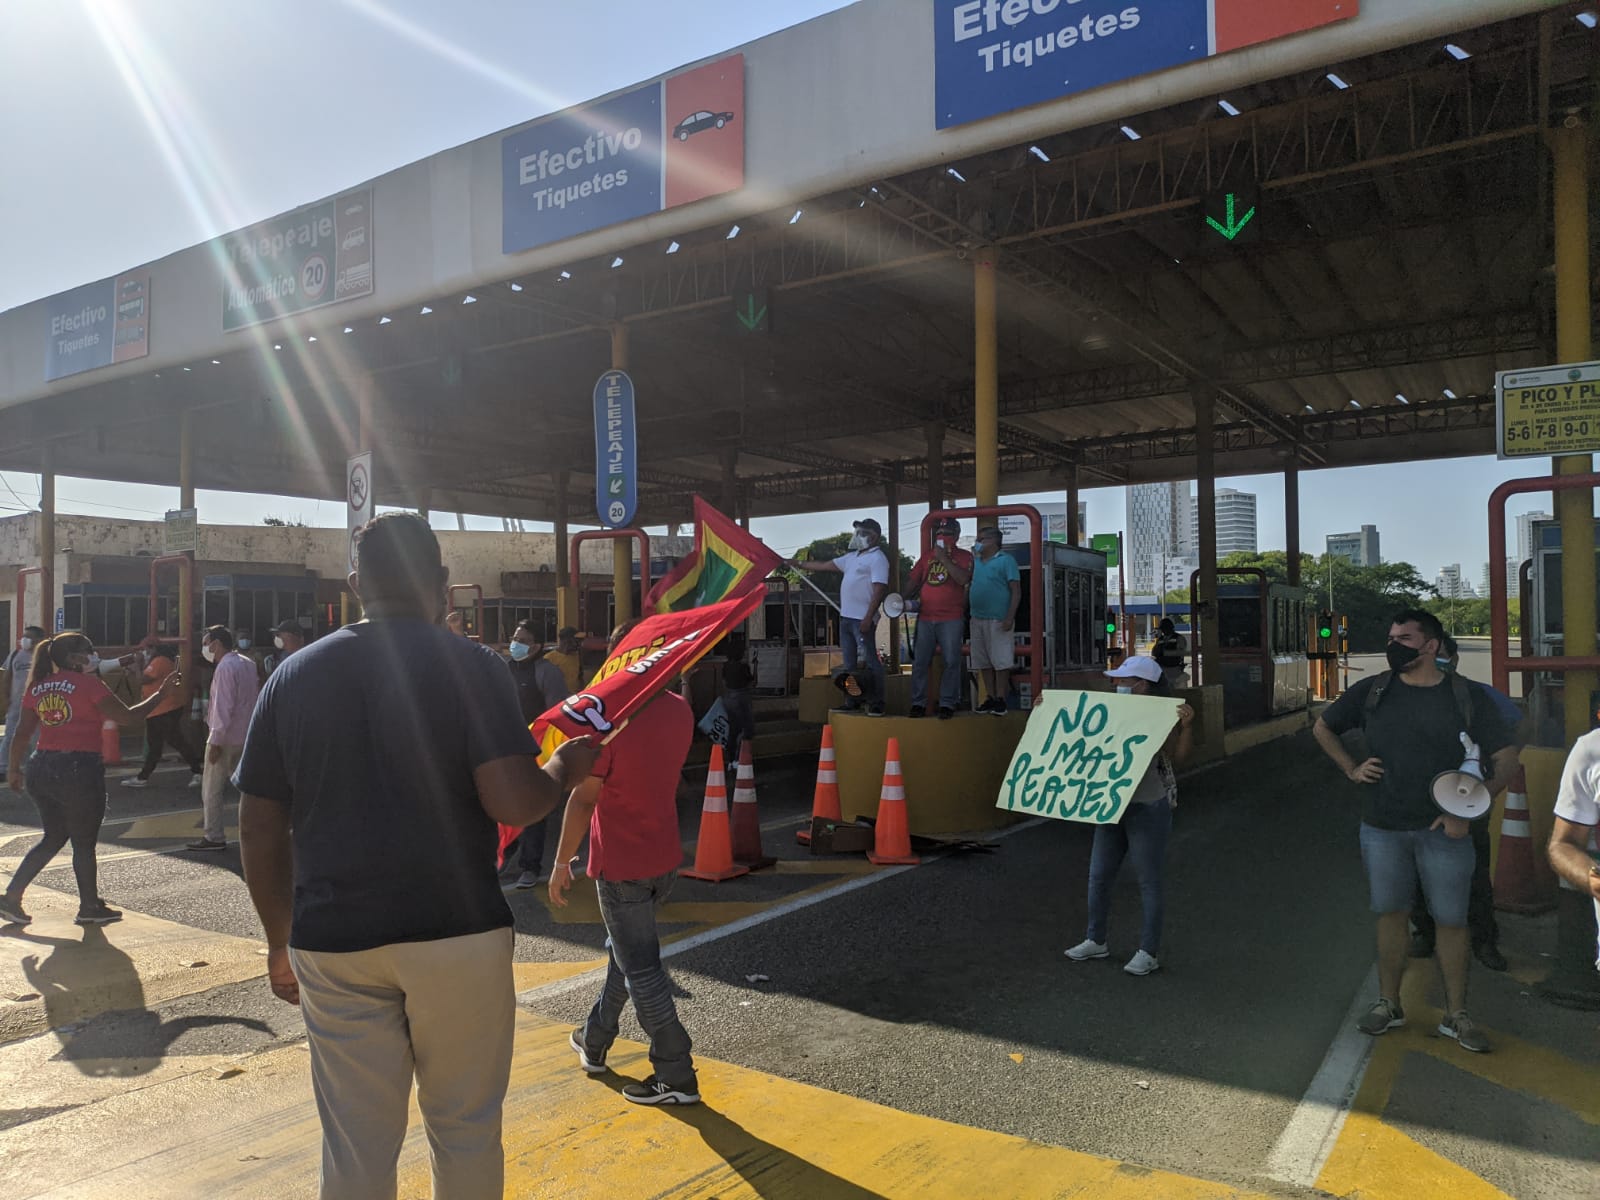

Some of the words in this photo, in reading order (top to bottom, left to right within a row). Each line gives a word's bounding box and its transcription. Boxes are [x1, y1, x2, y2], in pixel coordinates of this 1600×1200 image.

[977, 6, 1141, 72] Tiquetes
[519, 127, 642, 186] Efectivo
[533, 169, 629, 211] Tiquetes
[229, 215, 333, 262] Telepeaje
[305, 263, 324, 288] 20
[51, 305, 107, 337] Efectivo
[57, 333, 101, 355] Tiquetes
[1521, 388, 1558, 403] PICO
[1563, 386, 1573, 399] Y
[605, 374, 624, 474] TELEPEAJE
[1507, 426, 1530, 441] 5-6
[1535, 424, 1557, 439] 7-8
[1564, 421, 1588, 436] 9-0
[611, 507, 623, 518] 20
[31, 680, 76, 697] CAPITÁN
[1040, 691, 1109, 756] NO
[1006, 752, 1132, 822] PEAJES
